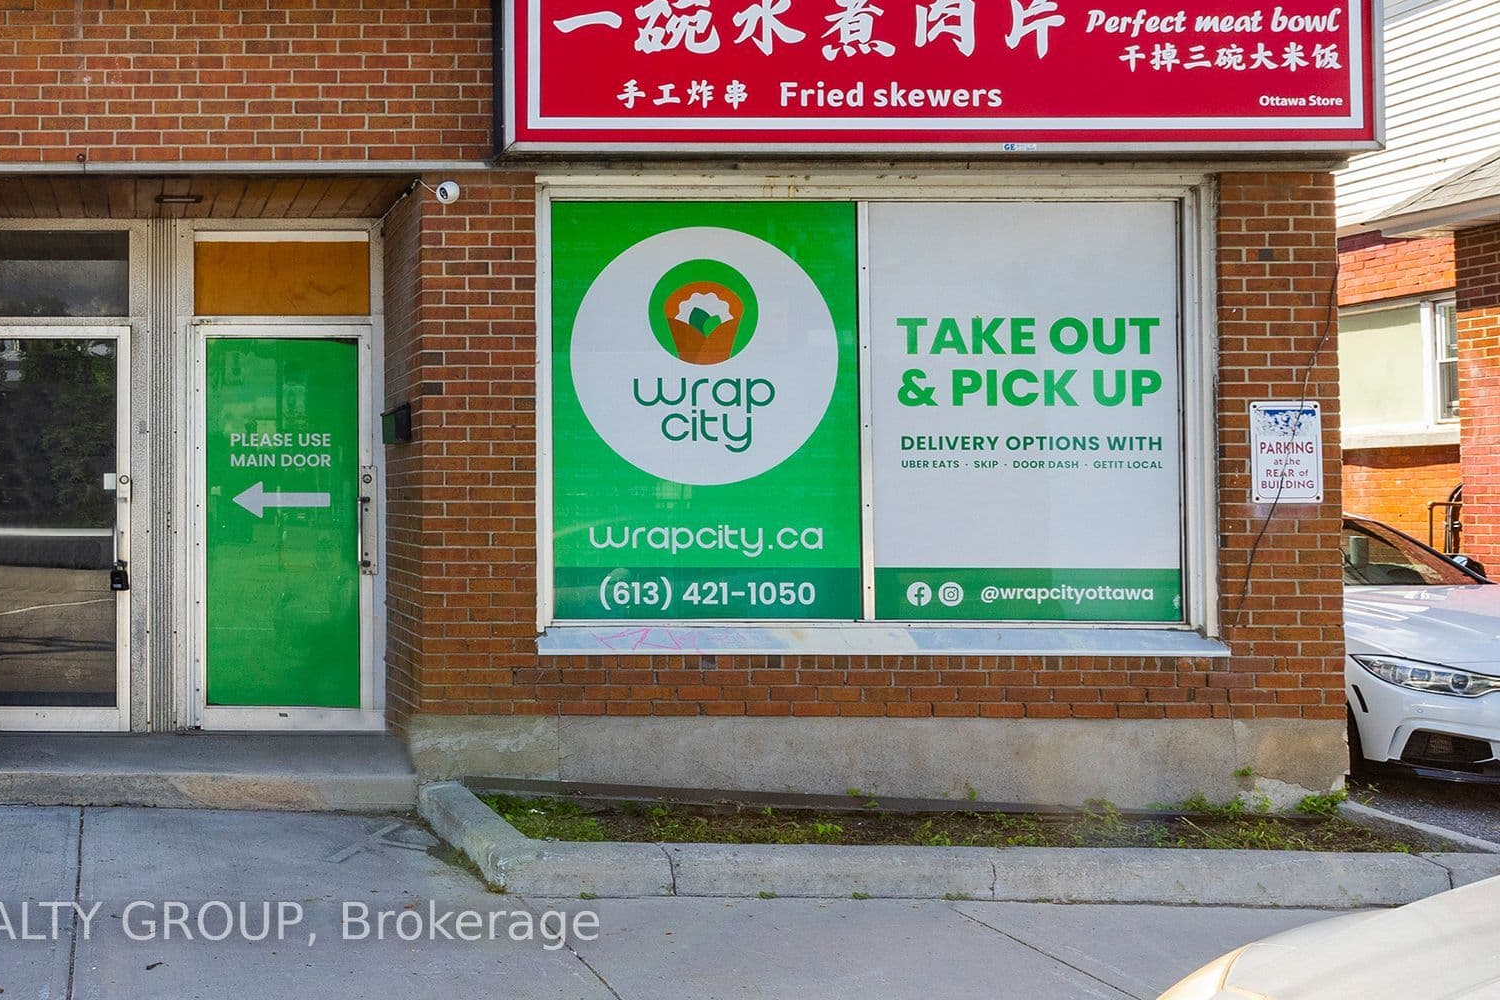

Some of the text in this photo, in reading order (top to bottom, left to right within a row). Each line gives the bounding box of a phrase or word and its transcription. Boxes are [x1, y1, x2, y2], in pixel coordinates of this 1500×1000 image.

[1086, 7, 1341, 37] Perfect meat bowl
[1119, 42, 1342, 72] 干掉三碗大米饭
[617, 80, 748, 109] 手工炸串
[780, 81, 1002, 107] Fried skewers
[1259, 95, 1343, 106] Ottawa Store
[897, 316, 1160, 354] TAKE OUT
[634, 378, 775, 410] wrap
[898, 369, 1162, 406] & PICK UP
[230, 432, 330, 447] PLEASE USE
[662, 408, 752, 452] city
[901, 436, 1162, 450] DELIVERY OPTIONS WITH
[231, 454, 330, 467] MAIN DOOR
[1260, 441, 1314, 454] PARKING
[902, 460, 929, 468] UBER
[933, 460, 959, 468] EATS
[1128, 461, 1163, 469] LOCAL
[1266, 469, 1308, 477] REAR of
[1261, 480, 1314, 488] BUILDING
[588, 525, 823, 557] wrapcity.ca
[600, 576, 815, 610] (613) 421-1050
[981, 584, 1153, 603] @wrapcityottawa
